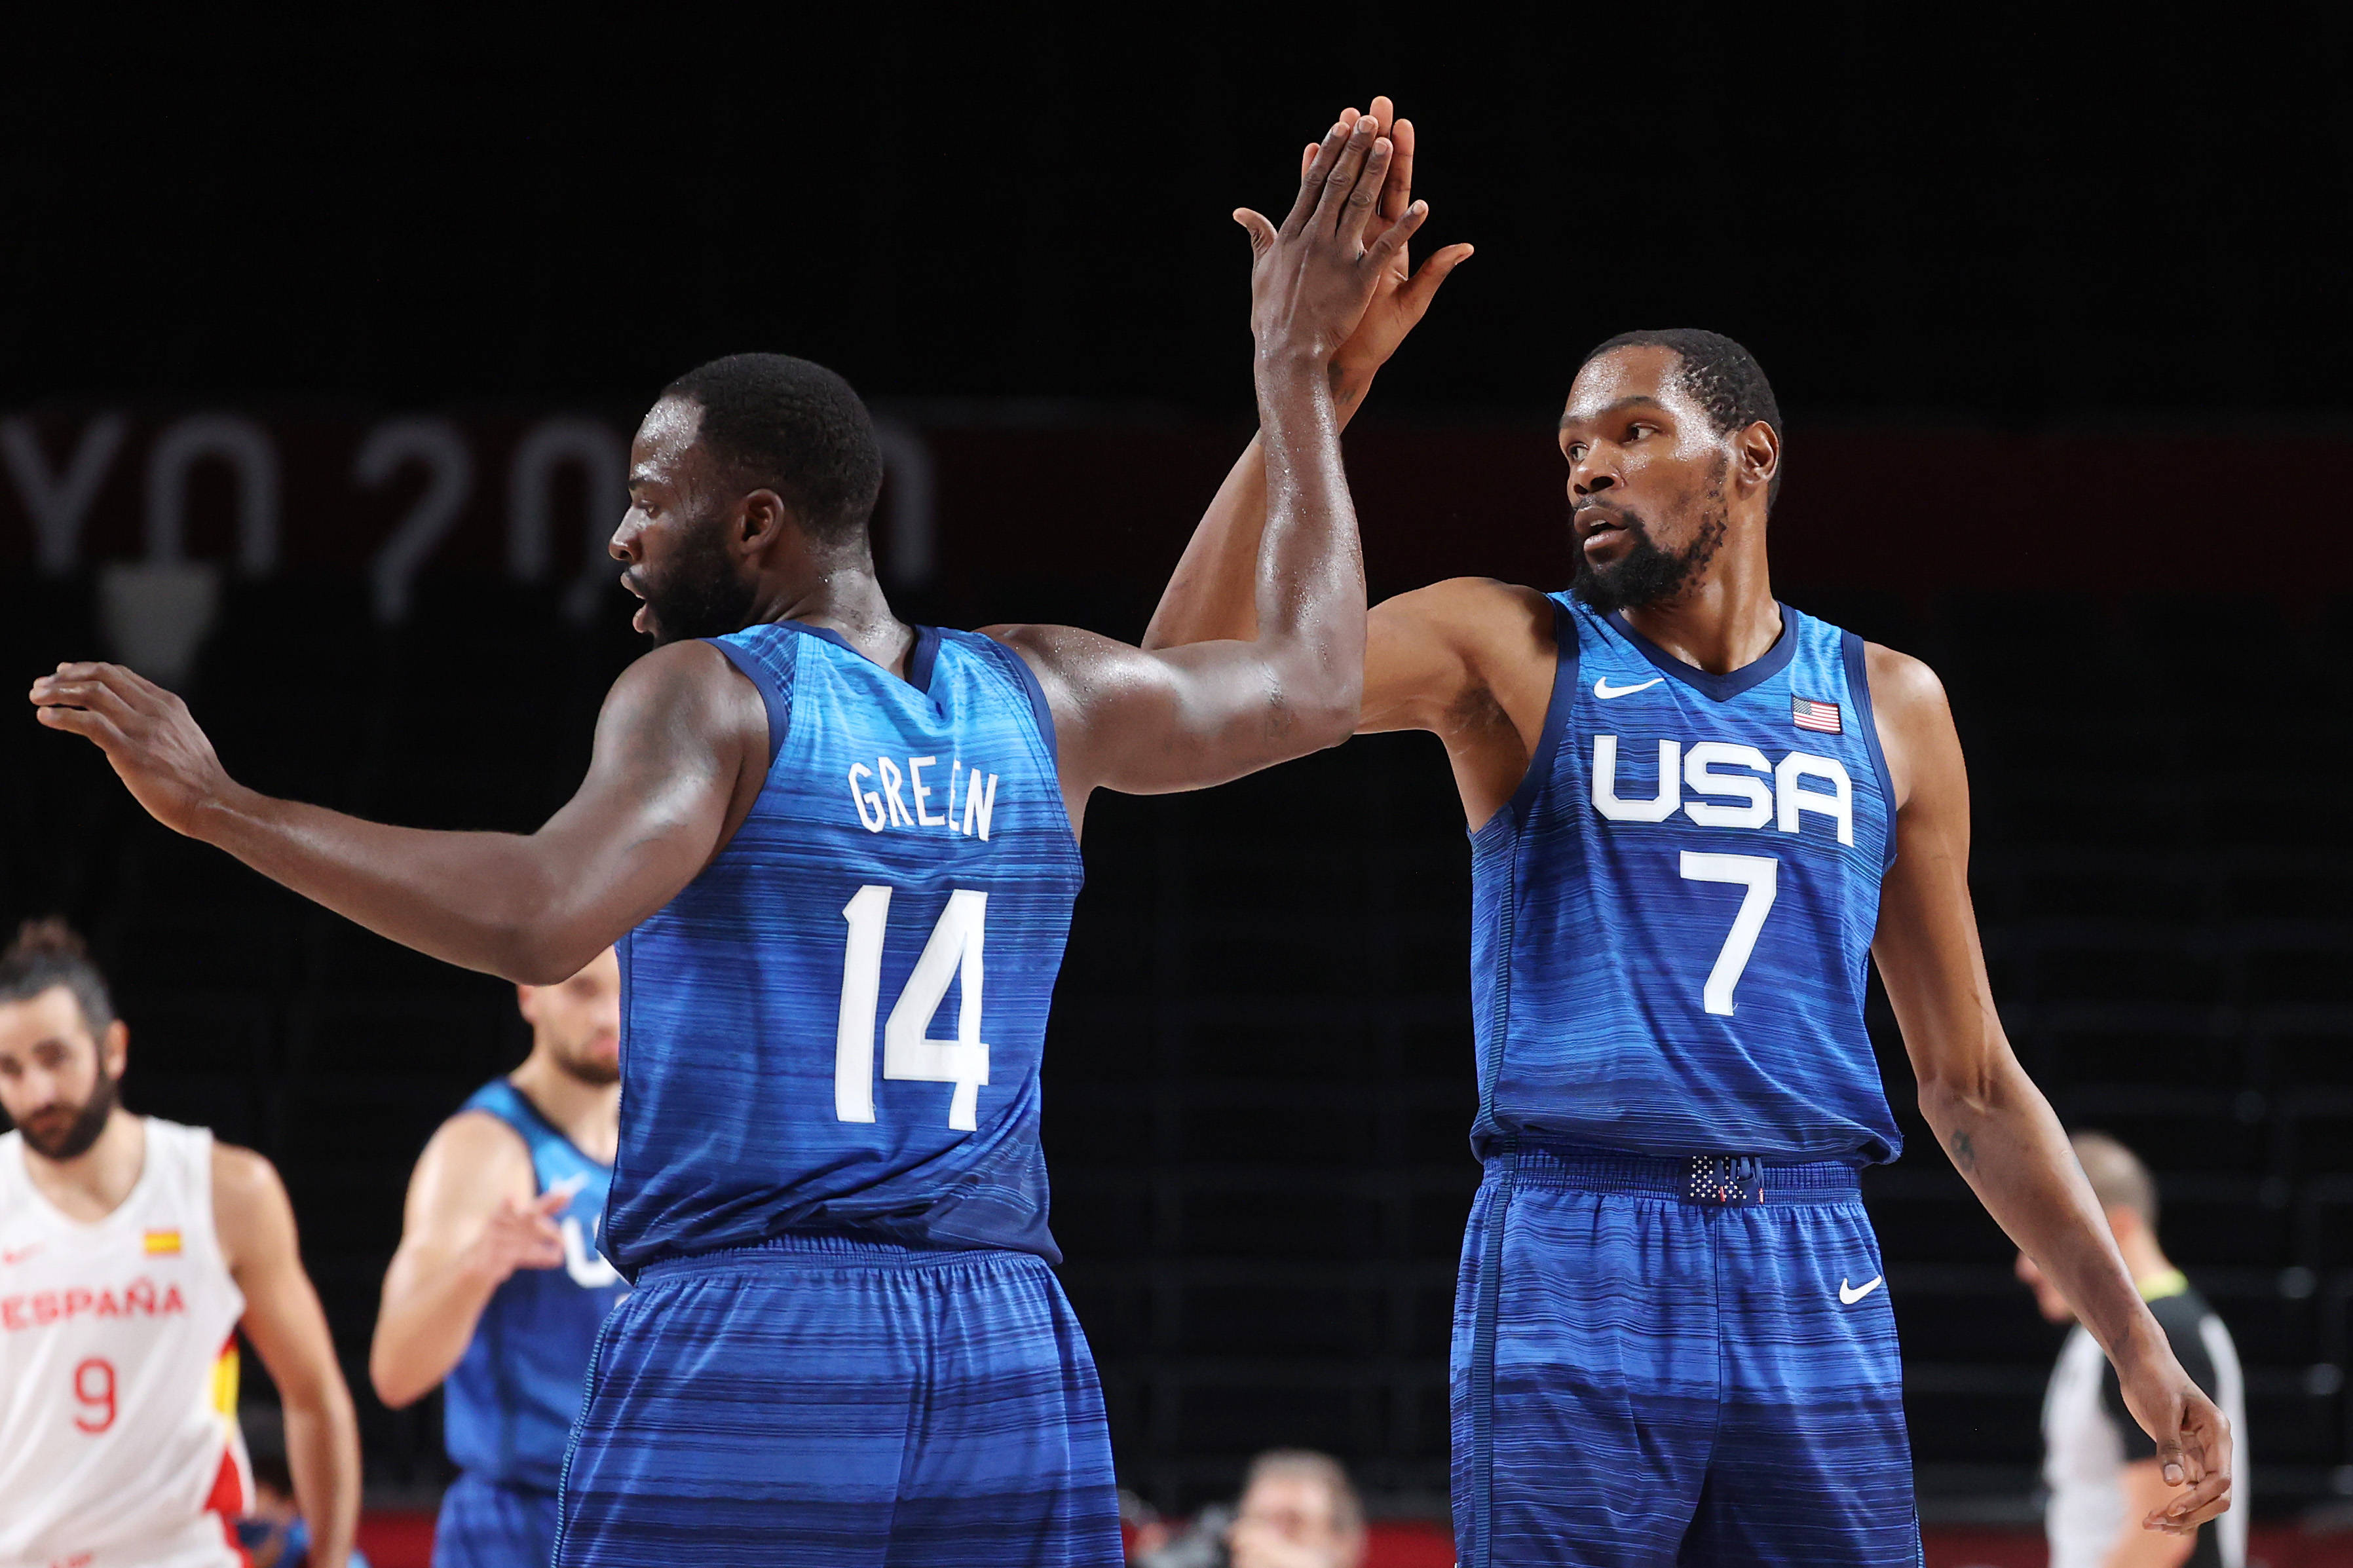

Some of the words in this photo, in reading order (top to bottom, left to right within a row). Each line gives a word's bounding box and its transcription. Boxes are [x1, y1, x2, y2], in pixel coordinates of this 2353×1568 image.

[1591, 735, 1854, 848] USA
[1680, 850, 1779, 1017] 7
[835, 885, 990, 1132] 14
[1, 1277, 187, 1332] ESPAÑA
[73, 1355, 117, 1434] 9
